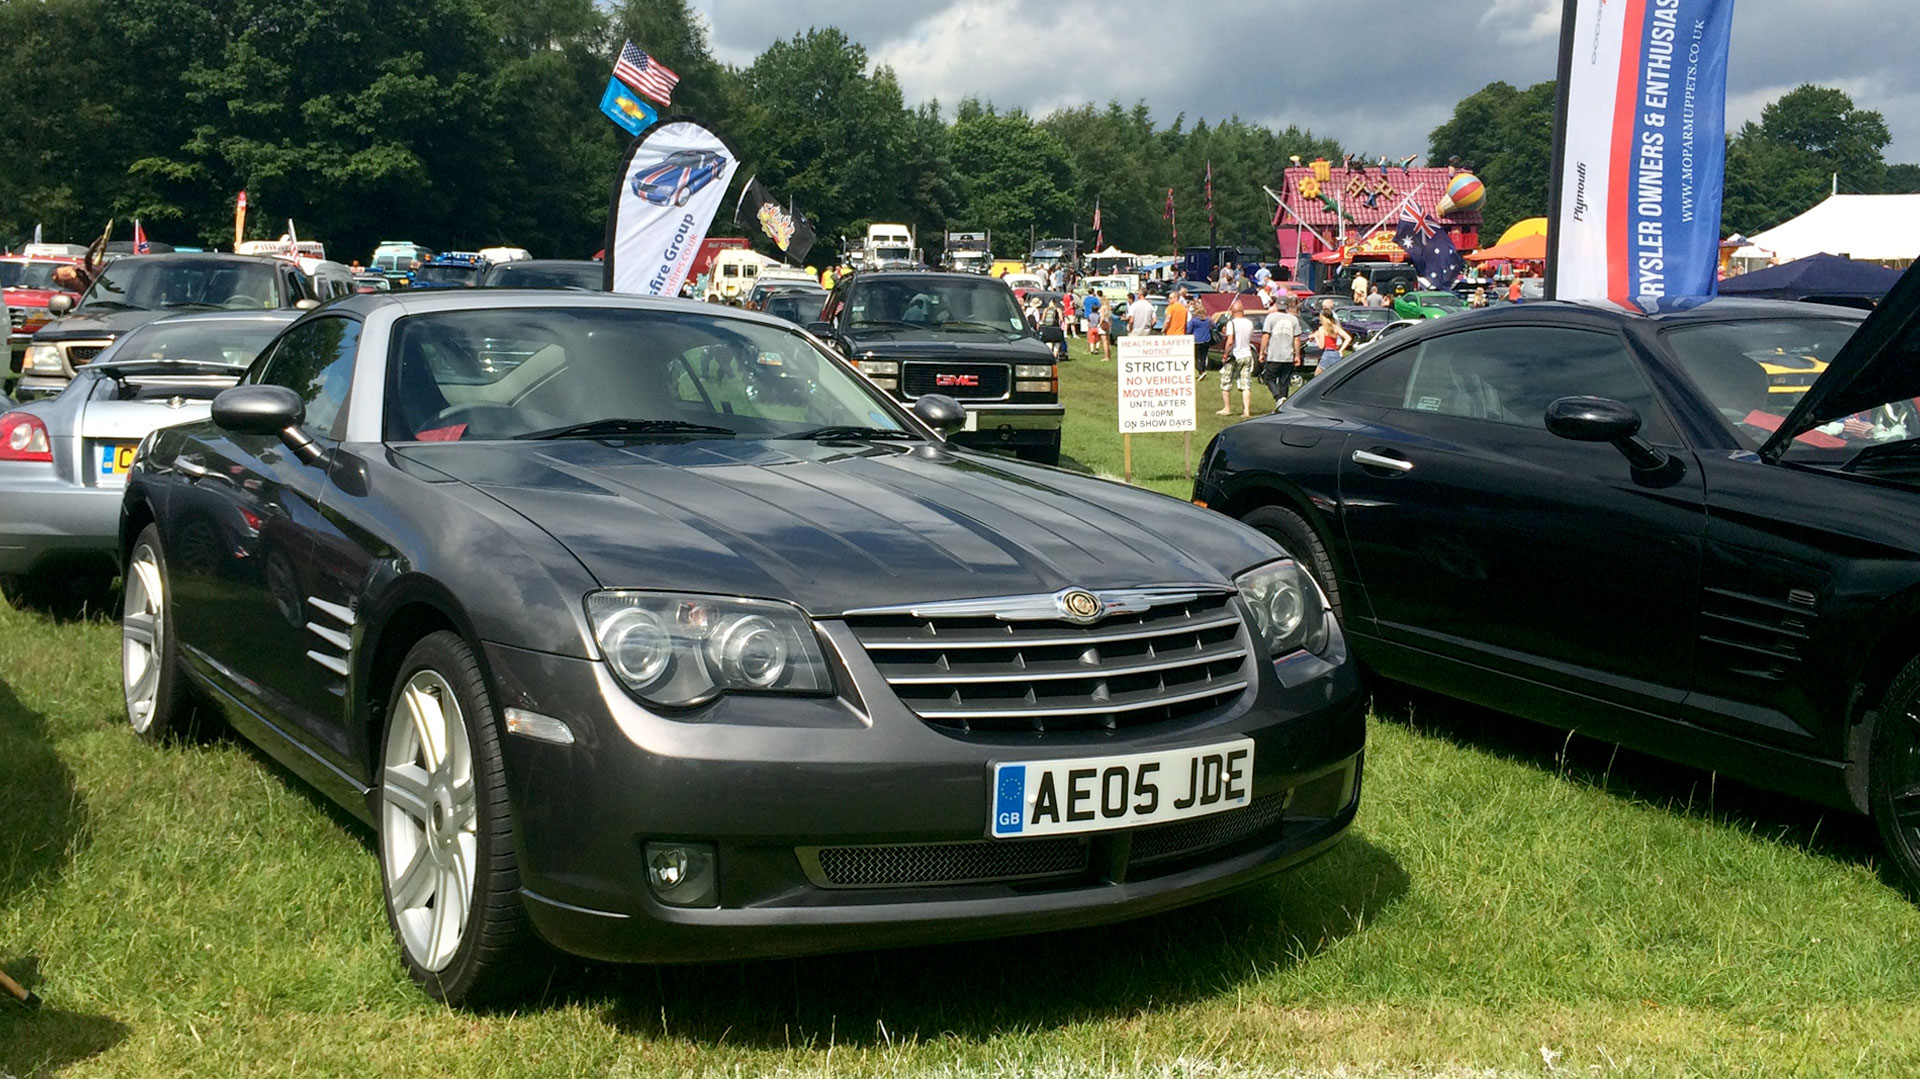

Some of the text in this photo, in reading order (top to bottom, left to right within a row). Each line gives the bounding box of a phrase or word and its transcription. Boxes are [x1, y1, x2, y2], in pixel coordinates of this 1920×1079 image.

[1644, 113, 1666, 128] &
[1682, 19, 1705, 223] WWW.MOPARMUPPETS.CO.UK
[1638, 131, 1664, 217] OWNERS
[1573, 161, 1589, 222] Plymouth
[664, 213, 695, 261] Group
[1121, 340, 1152, 348] HEALTH
[1125, 360, 1190, 373] STRICTLY
[936, 374, 979, 386] GMC
[1126, 375, 1192, 386] NO VEHICLE
[1123, 387, 1193, 398] MOVEMENTS
[1130, 399, 1186, 408] UNTIL AFTER
[1124, 418, 1193, 428] ON SHOW DAYS
[1031, 748, 1248, 824] AE05 JDE
[999, 812, 1020, 825] GB
